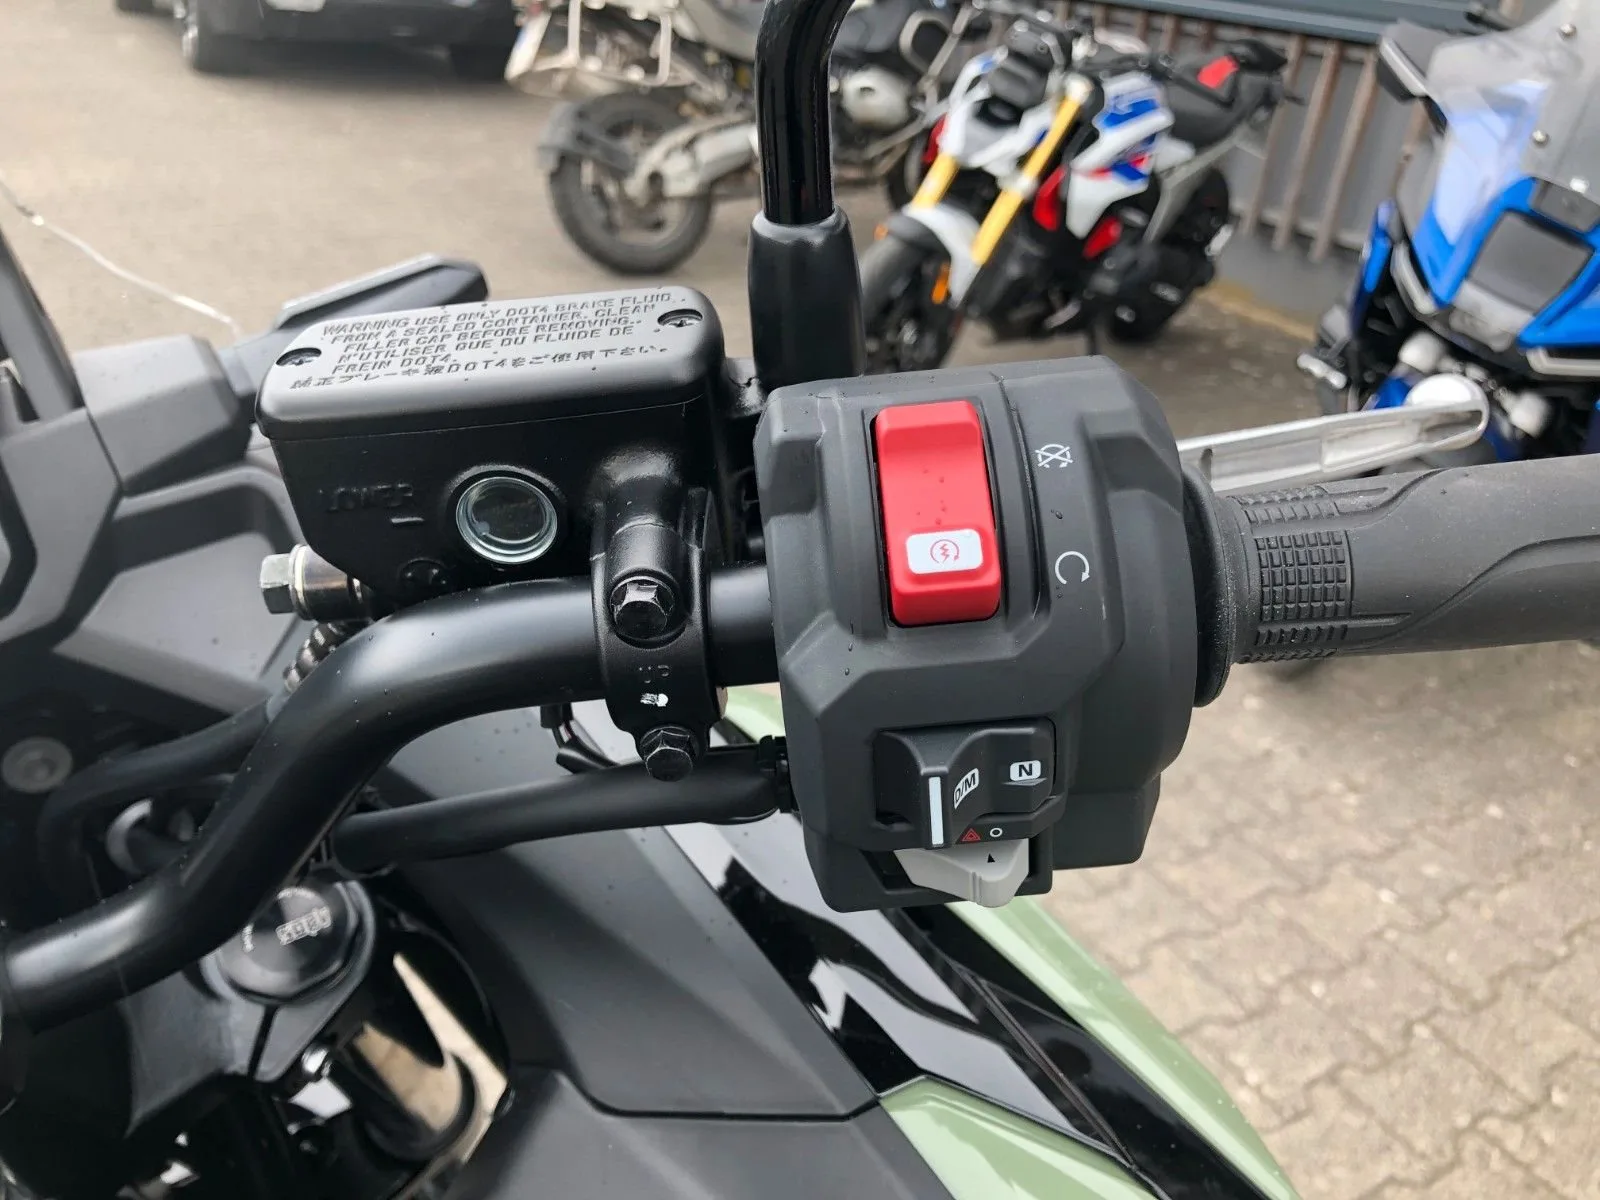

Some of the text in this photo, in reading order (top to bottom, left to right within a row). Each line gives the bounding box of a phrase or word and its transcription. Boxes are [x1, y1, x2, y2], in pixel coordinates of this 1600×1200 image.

[323, 317, 410, 336] WARNING
[415, 314, 451, 326] USE
[456, 309, 500, 321] ONLY
[506, 304, 549, 317] DOT4
[555, 298, 616, 311] BRAKE
[331, 331, 381, 344] FROM
[386, 329, 397, 339] A
[403, 322, 476, 337] SEALED
[595, 303, 655, 318] CLEAN
[338, 325, 634, 364] N'UTILISER QUE DU FLUIDE DE
[344, 337, 409, 353] FILLER
[416, 333, 452, 346] CAP
[457, 325, 531, 342] BEFORE
[332, 360, 391, 375] FREIN
[955, 772, 976, 803] D/M
